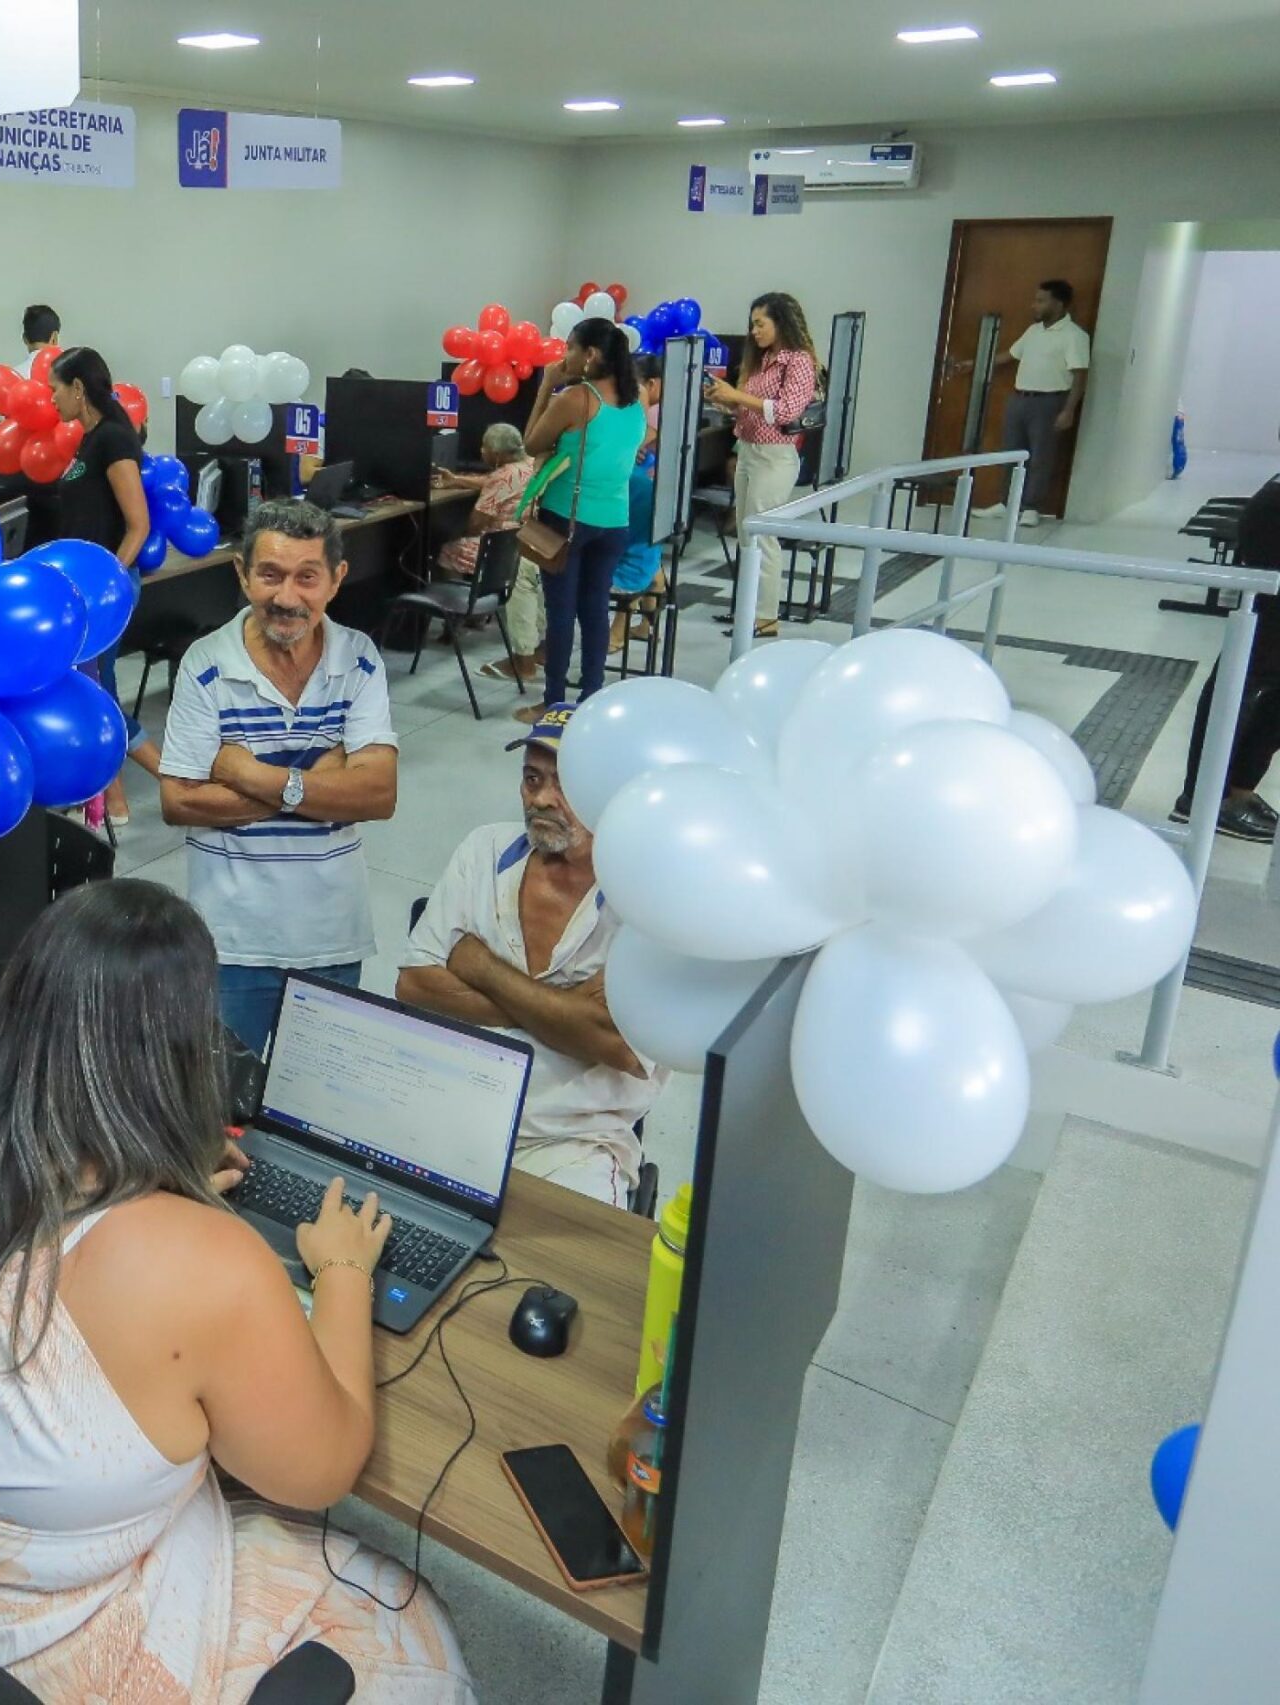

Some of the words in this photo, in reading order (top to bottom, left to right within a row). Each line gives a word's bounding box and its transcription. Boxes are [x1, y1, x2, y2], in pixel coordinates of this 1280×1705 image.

[28, 108, 124, 135] SECRETARIA
[71, 133, 92, 153] DE
[244, 144, 282, 161] JUNTA
[283, 146, 328, 163] MILITAR
[436, 385, 450, 410] 06
[295, 407, 311, 435] 05
